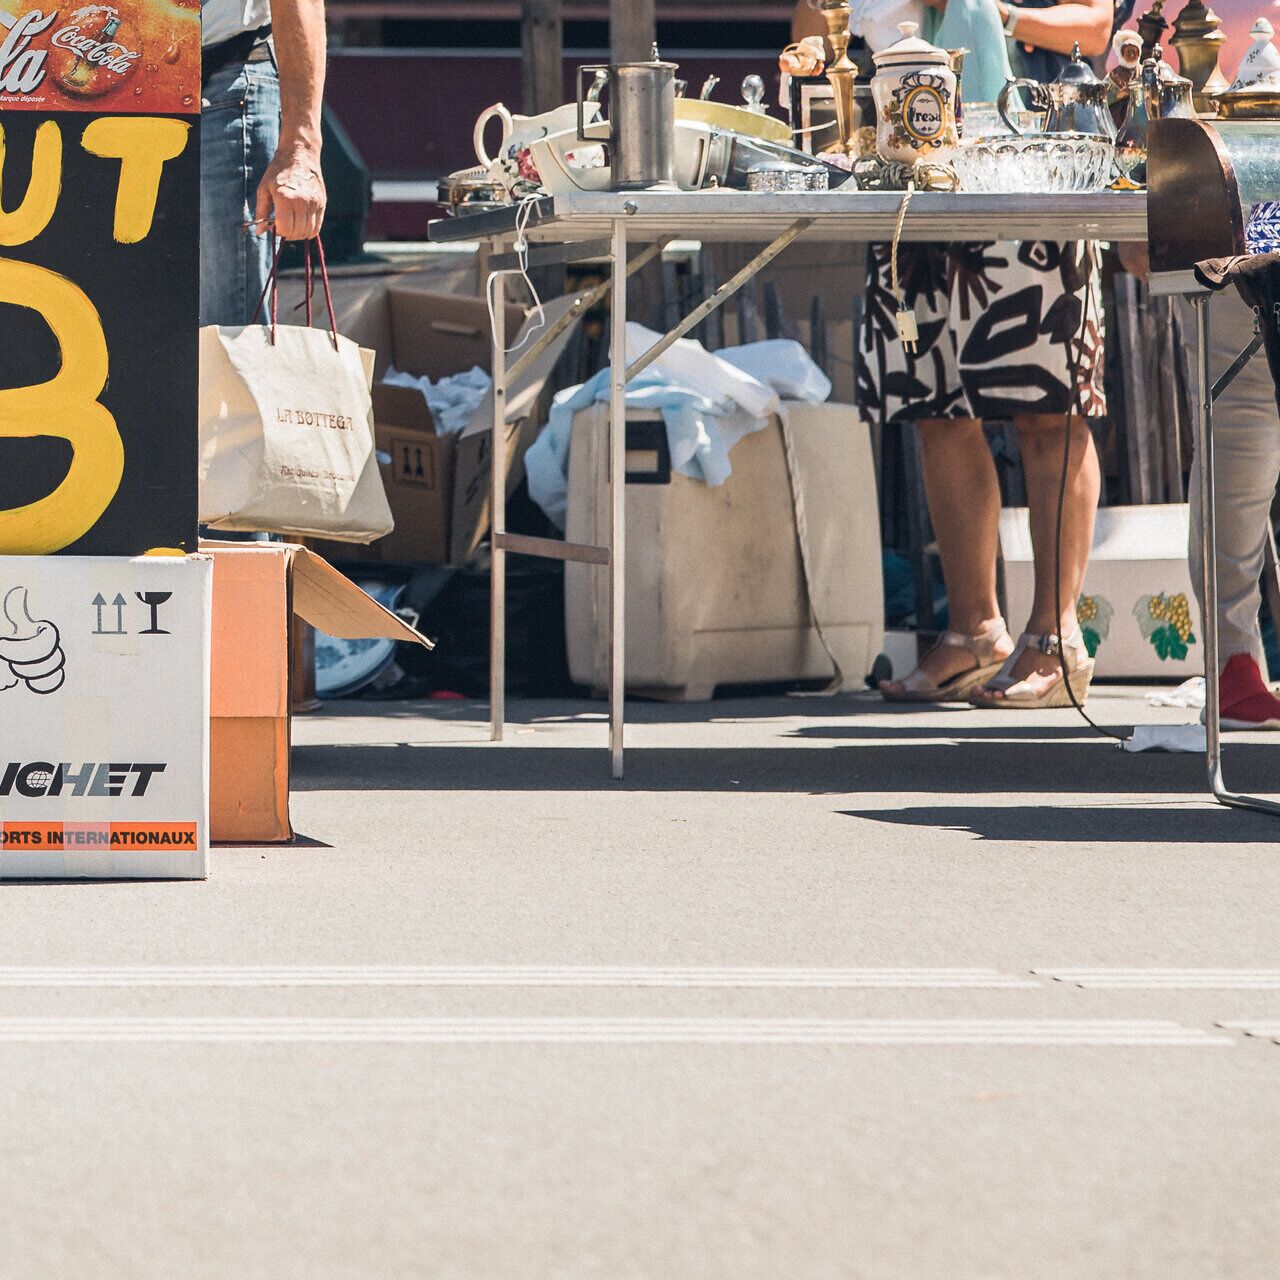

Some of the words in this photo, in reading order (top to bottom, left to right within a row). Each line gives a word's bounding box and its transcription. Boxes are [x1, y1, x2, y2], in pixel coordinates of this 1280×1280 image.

[51, 25, 142, 74] Coca-Cola
[20, 96, 46, 104] déposée
[276, 409, 293, 423] LA
[296, 410, 354, 431] BOTTEGA
[47, 831, 195, 845] INTERNATIONAUX
